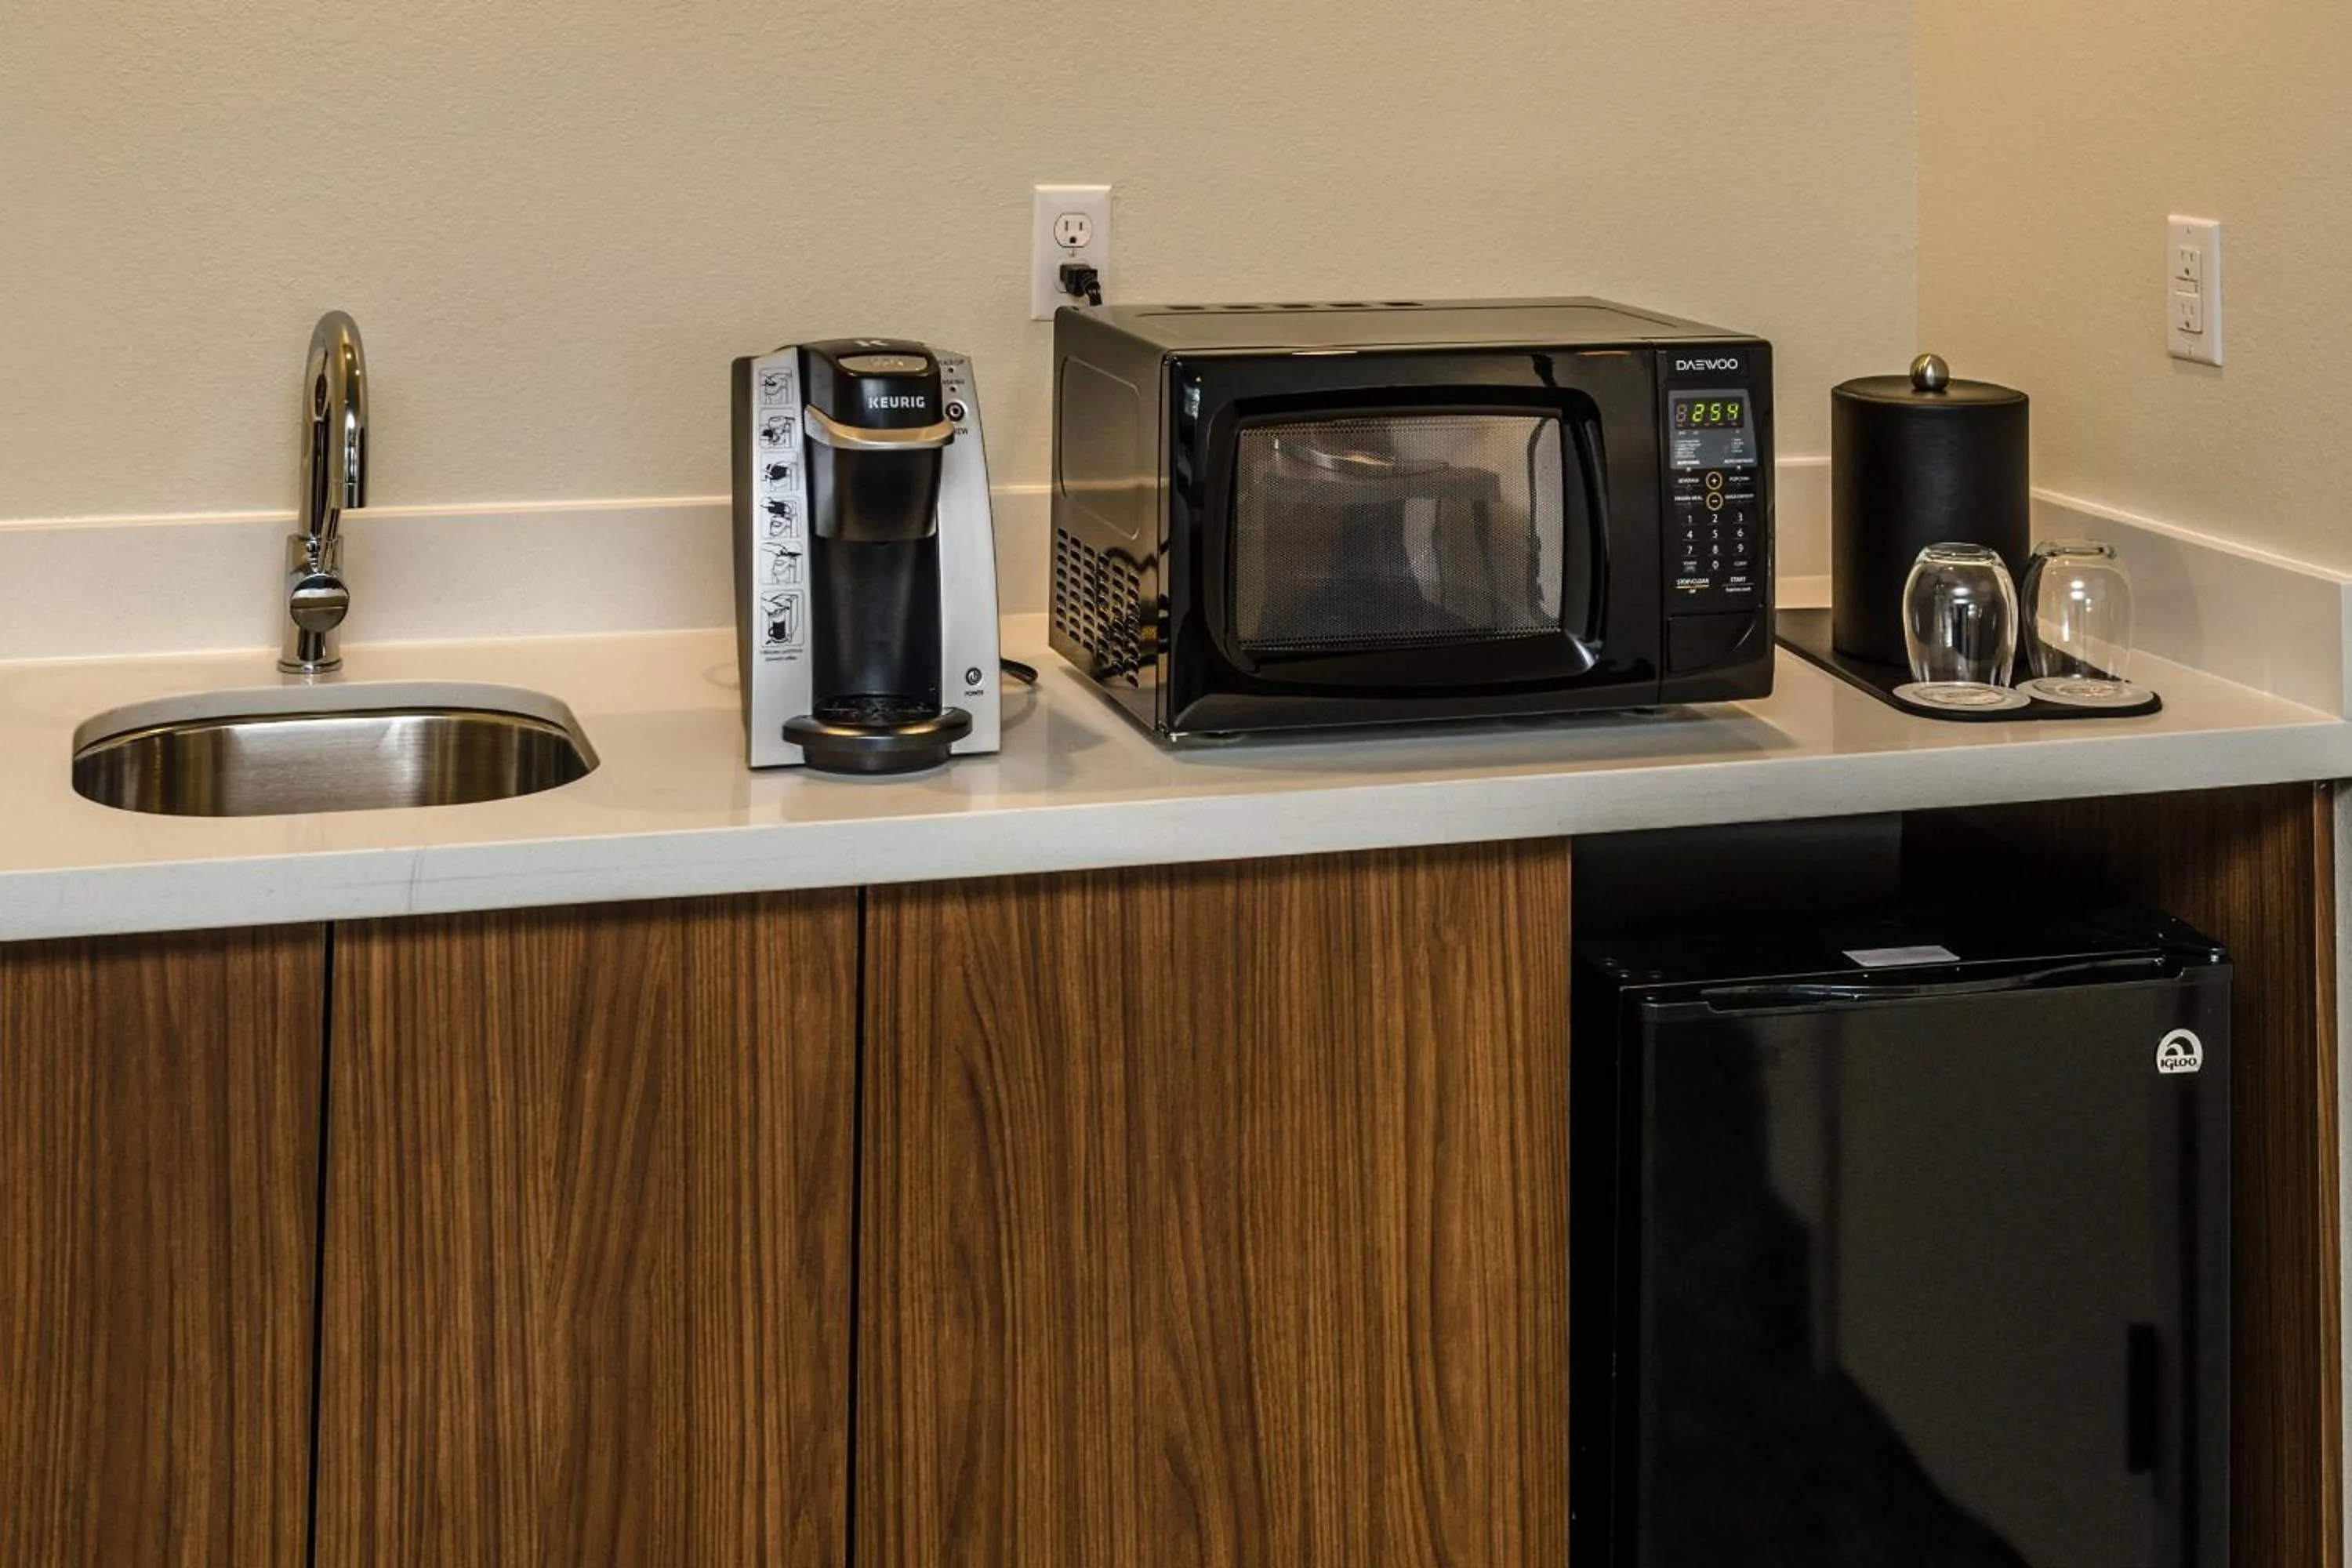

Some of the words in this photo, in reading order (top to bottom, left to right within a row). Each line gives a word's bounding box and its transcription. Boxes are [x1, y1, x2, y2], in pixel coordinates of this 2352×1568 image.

[1675, 358, 1738, 370] DAEWOO
[868, 396, 925, 408] KEURIG
[1687, 514, 1693, 524] 1
[1712, 514, 1719, 523] 2
[1737, 512, 1744, 521] 3
[1686, 529, 1693, 539] 4
[1712, 529, 1719, 539] 5
[1737, 528, 1744, 537] 6
[1687, 545, 1693, 555] 7
[1711, 545, 1719, 554] 8
[1737, 543, 1744, 553] 9
[1711, 561, 1719, 570] 0
[2160, 1058, 2197, 1071] IGLOO
